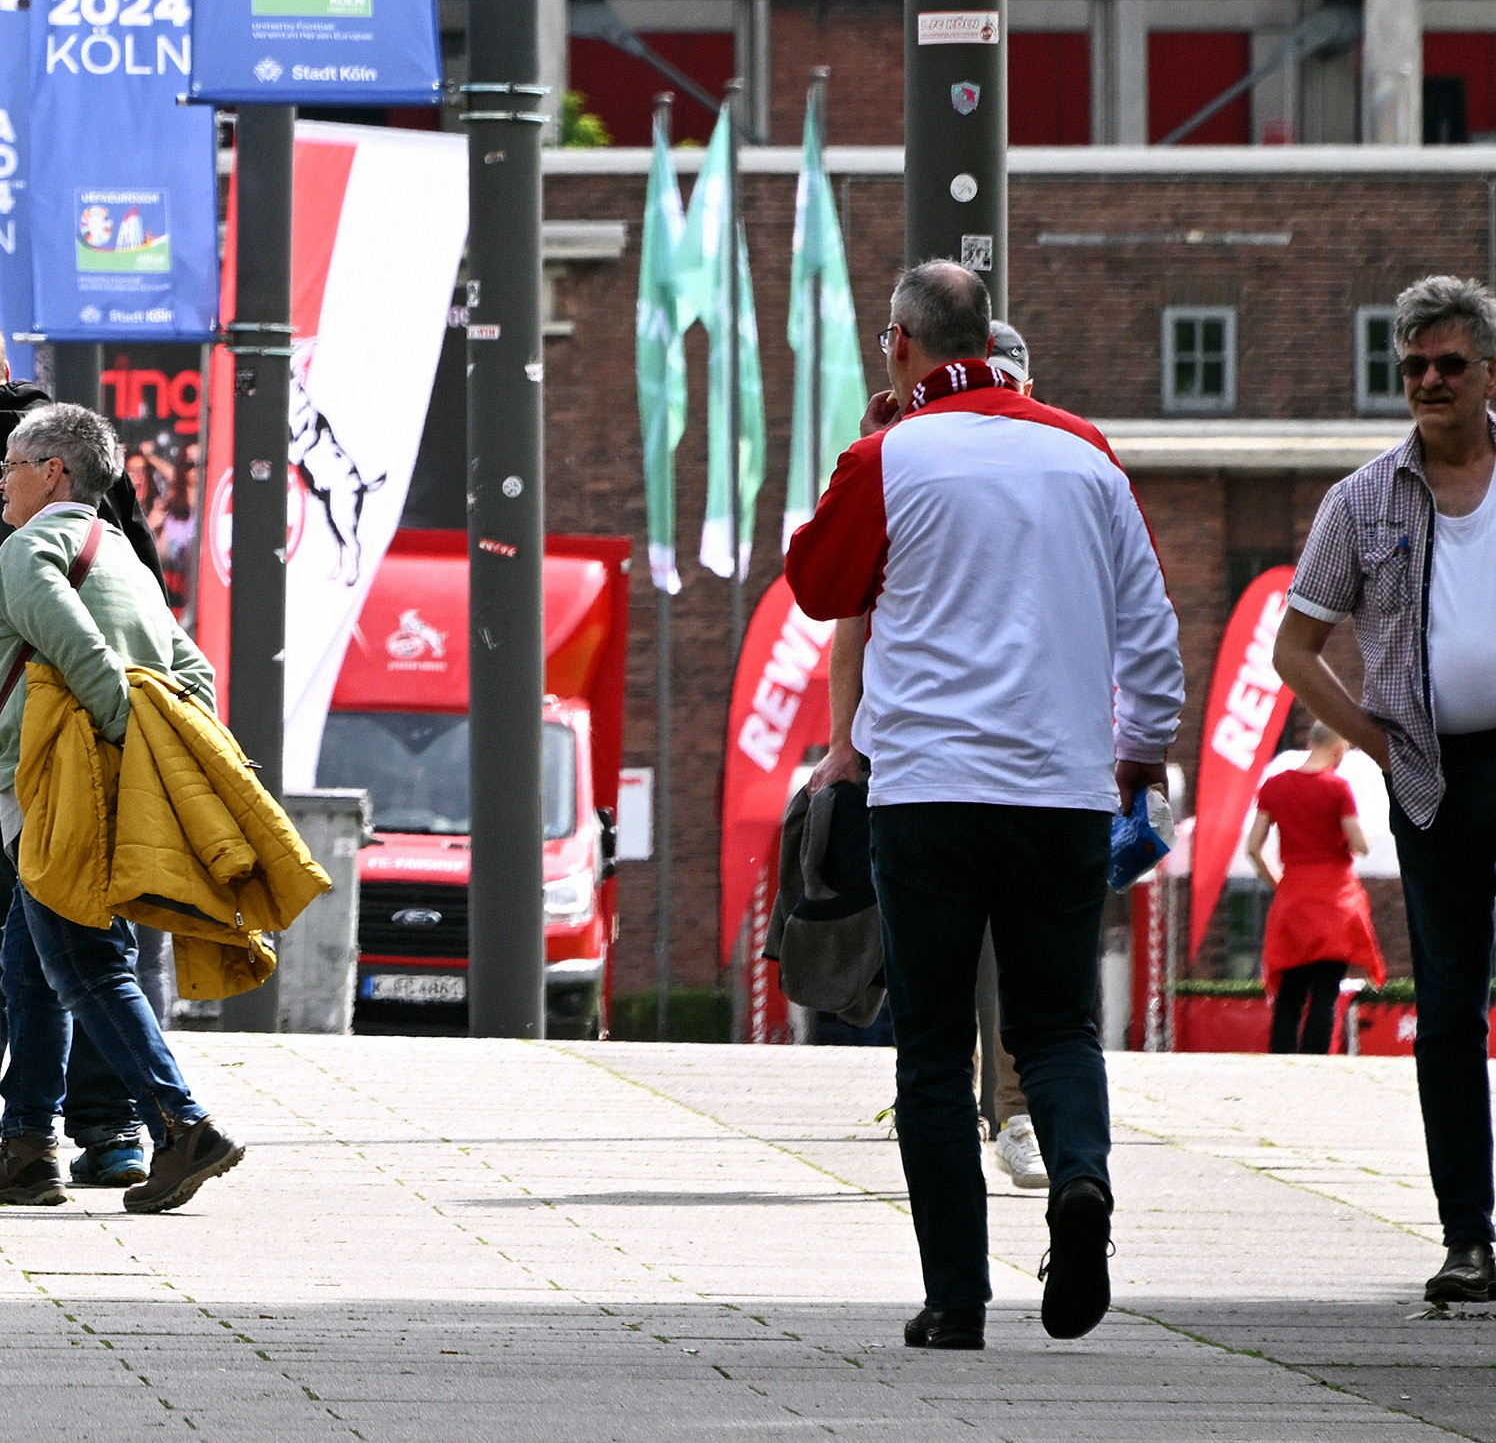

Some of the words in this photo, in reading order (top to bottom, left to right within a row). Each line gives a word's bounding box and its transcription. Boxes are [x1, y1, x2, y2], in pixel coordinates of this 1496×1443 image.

[946, 16, 980, 30] KÖLN
[46, 26, 192, 75] KÖLN
[292, 64, 338, 81] Stadt
[340, 64, 379, 81] Köln
